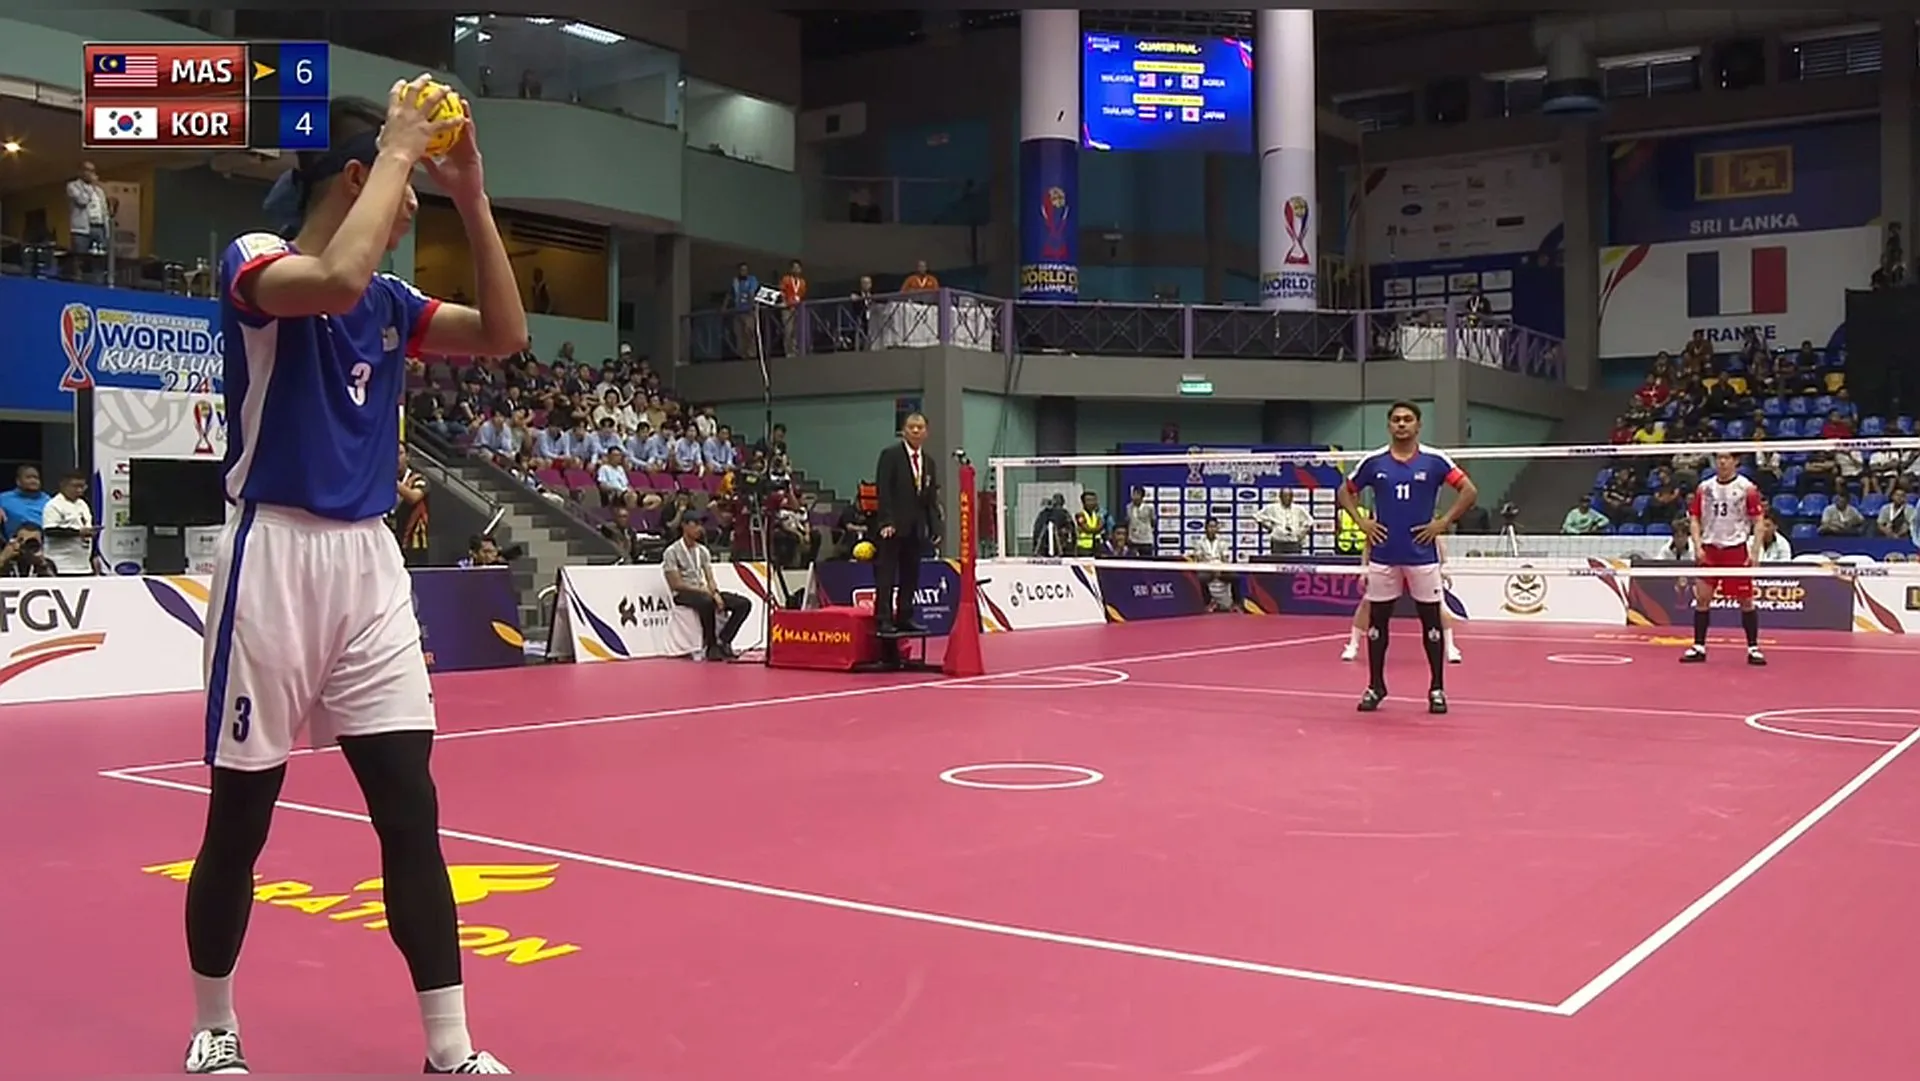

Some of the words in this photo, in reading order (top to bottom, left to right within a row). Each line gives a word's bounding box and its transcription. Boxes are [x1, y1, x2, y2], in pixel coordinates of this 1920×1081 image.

[1690, 219, 1722, 234] SRI
[1729, 213, 1799, 231] LANKA
[98, 322, 213, 354] WORLD
[1692, 324, 1777, 342] RANE
[101, 350, 174, 371] KUALA
[178, 356, 224, 377] LUM
[346, 362, 372, 407] 3
[1395, 484, 1410, 500] 11
[1713, 502, 1728, 517] 13
[1026, 584, 1074, 601] LOCCA
[1765, 587, 1805, 600] CUP
[0, 588, 90, 632] FGV
[784, 629, 851, 643] MARATHON
[232, 695, 252, 744] 3
